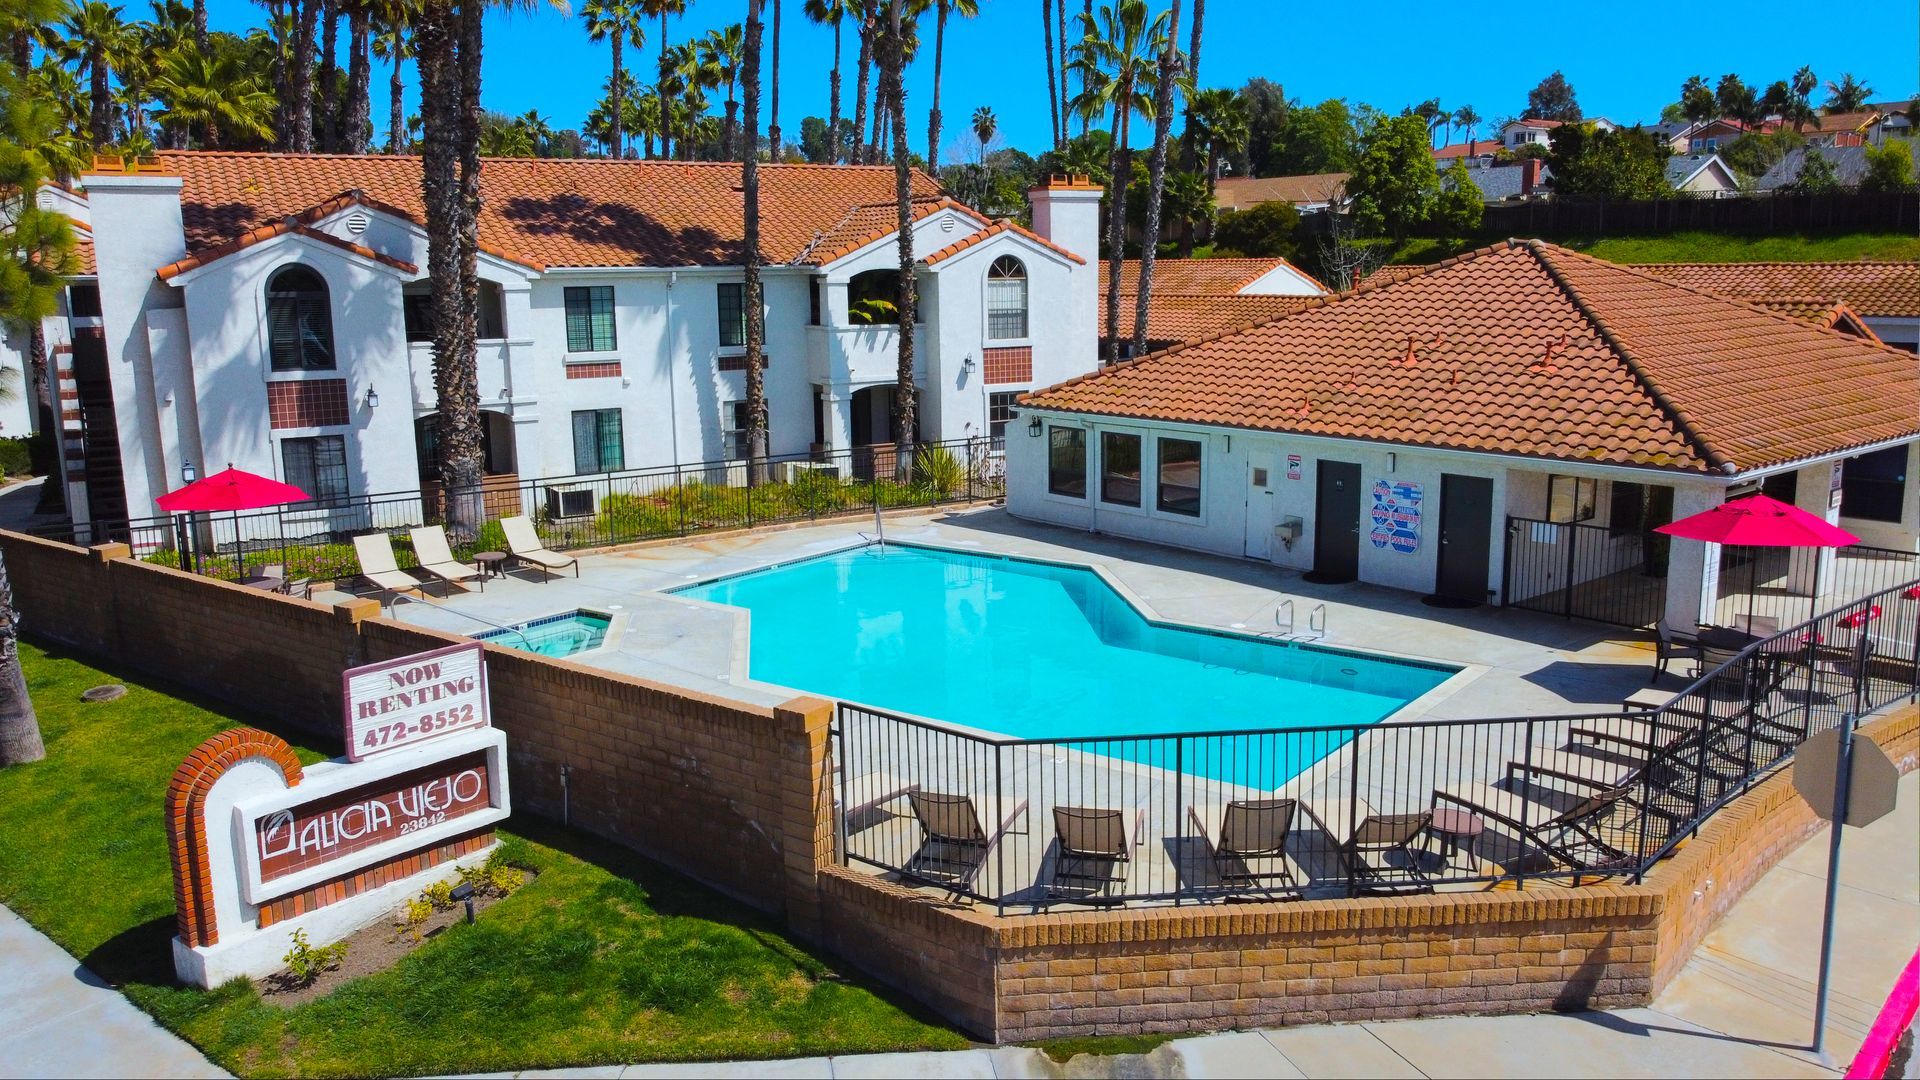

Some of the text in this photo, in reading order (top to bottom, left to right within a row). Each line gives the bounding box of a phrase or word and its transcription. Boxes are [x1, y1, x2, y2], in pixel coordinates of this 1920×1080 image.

[356, 676, 475, 720] RENTING
[388, 661, 443, 691] NOW
[363, 704, 474, 748] 472-8552
[300, 800, 392, 856] ALICIA
[400, 811, 447, 835] 23842
